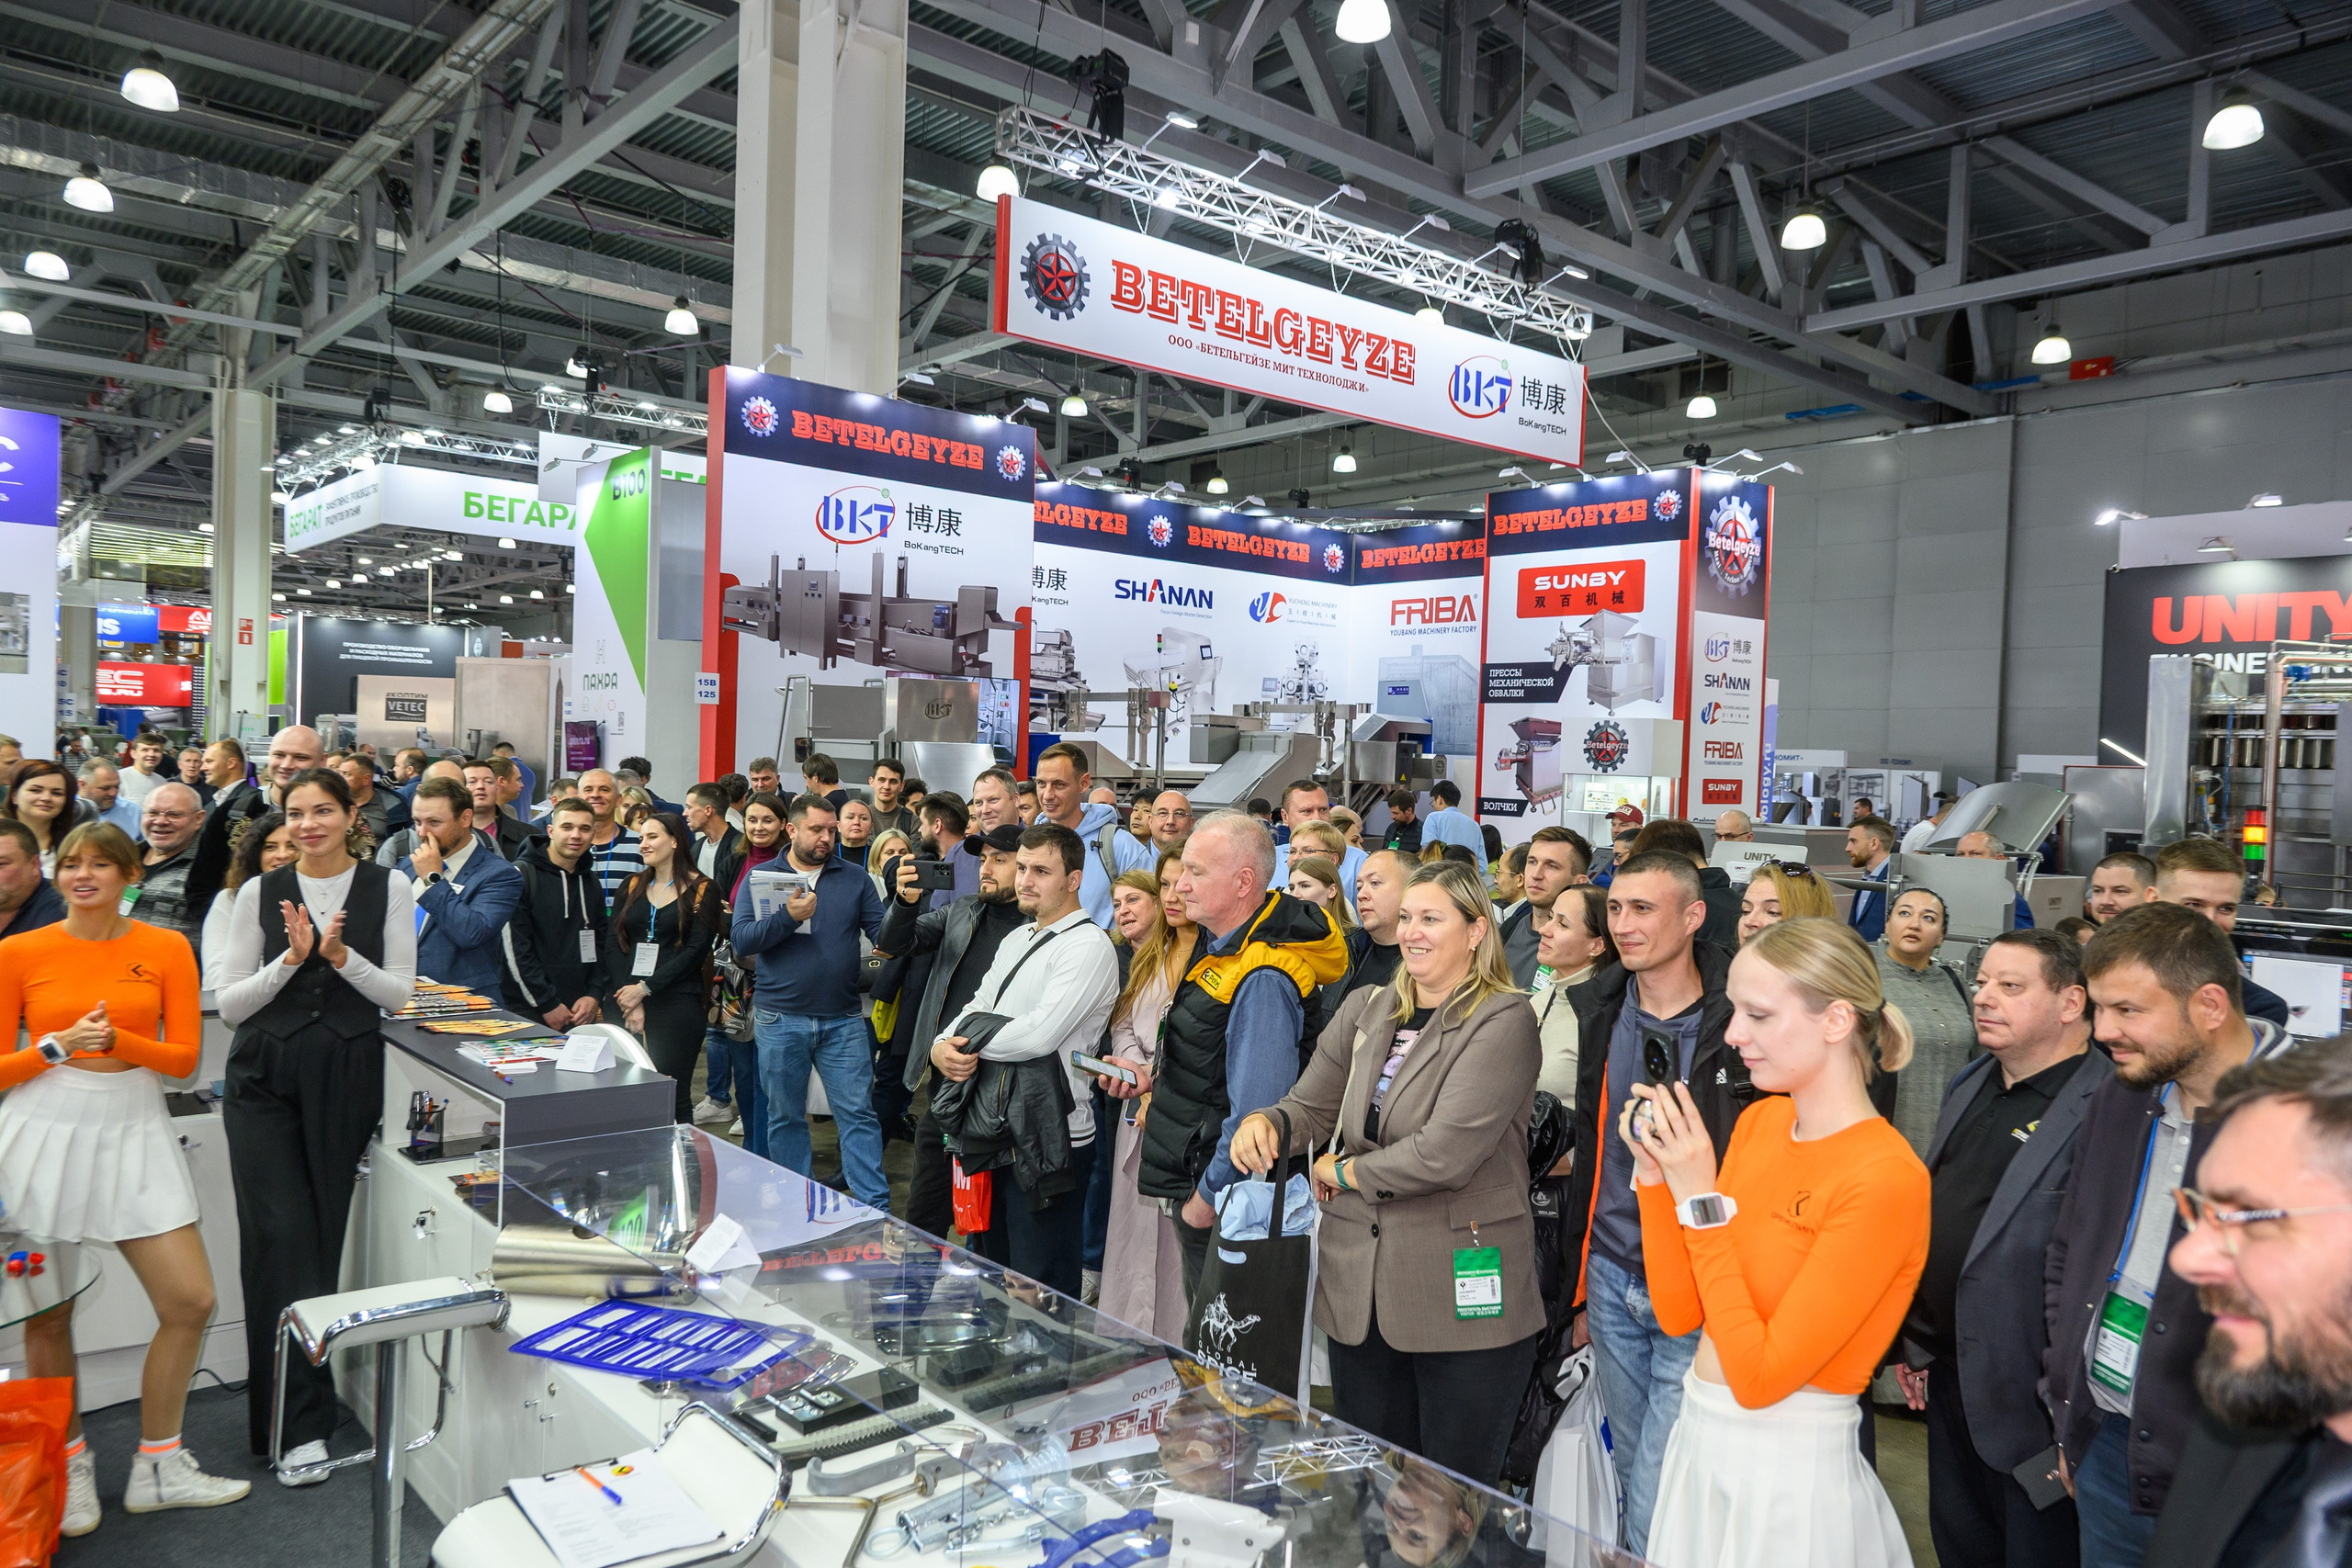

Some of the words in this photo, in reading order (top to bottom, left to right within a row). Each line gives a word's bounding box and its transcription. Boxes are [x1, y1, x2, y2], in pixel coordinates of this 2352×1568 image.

[1110, 259, 1416, 386] BETELGEYZE
[1168, 334, 1193, 349] ООО
[1195, 342, 1272, 370] «БЕТЕЛЬГЕЙЗЕ
[1272, 361, 1295, 376] МИТ
[1296, 367, 1370, 393] ТЕХНОЛОДЖИ»
[1453, 364, 1512, 413] BKT
[1521, 376, 1567, 415] 博康
[1518, 416, 1567, 436] BoKangTECH
[791, 410, 984, 470] BETELGEYZE
[821, 495, 896, 538] BKT
[905, 502, 963, 537] 博康
[1493, 499, 1648, 536] BETELGEYZE
[904, 540, 965, 556] BoKangTECH
[1187, 525, 1310, 563] BETELGEYZE
[1362, 538, 1485, 568] BETELGEYZE
[1708, 531, 1761, 558] Betelgeyze
[1534, 570, 1626, 591] SUNBY
[1032, 596, 1069, 606] KangTECH
[1114, 579, 1214, 610] SHANAN
[1288, 598, 1311, 606] YUCHENG
[1311, 601, 1338, 609] MACHINERY
[1391, 595, 1477, 626] FRIBA
[2152, 590, 2352, 645] UNITY
[1390, 628, 1417, 637] YOUBANG
[1418, 627, 1450, 636] MACHINERY
[1451, 626, 1477, 634] FACTORY
[582, 672, 618, 691] ПАХРА
[1489, 669, 1522, 678] ПРЕССЫ
[1489, 676, 1554, 688] МЕХАНИЧЕСКОЙ
[1704, 672, 1750, 691] SHANAN
[1488, 689, 1525, 697] ОБВАЛКИ
[388, 701, 425, 712] VETEC
[1586, 740, 1628, 751] Betelgeyze
[1704, 740, 1744, 760] FRIBA
[1708, 784, 1738, 793] SUNBY
[1483, 801, 1518, 812] ВОЛЧКИ
[1744, 852, 1777, 862] UNITY
[1198, 1339, 1257, 1371] GLOBAL
[1196, 1348, 1257, 1387] SPICE
